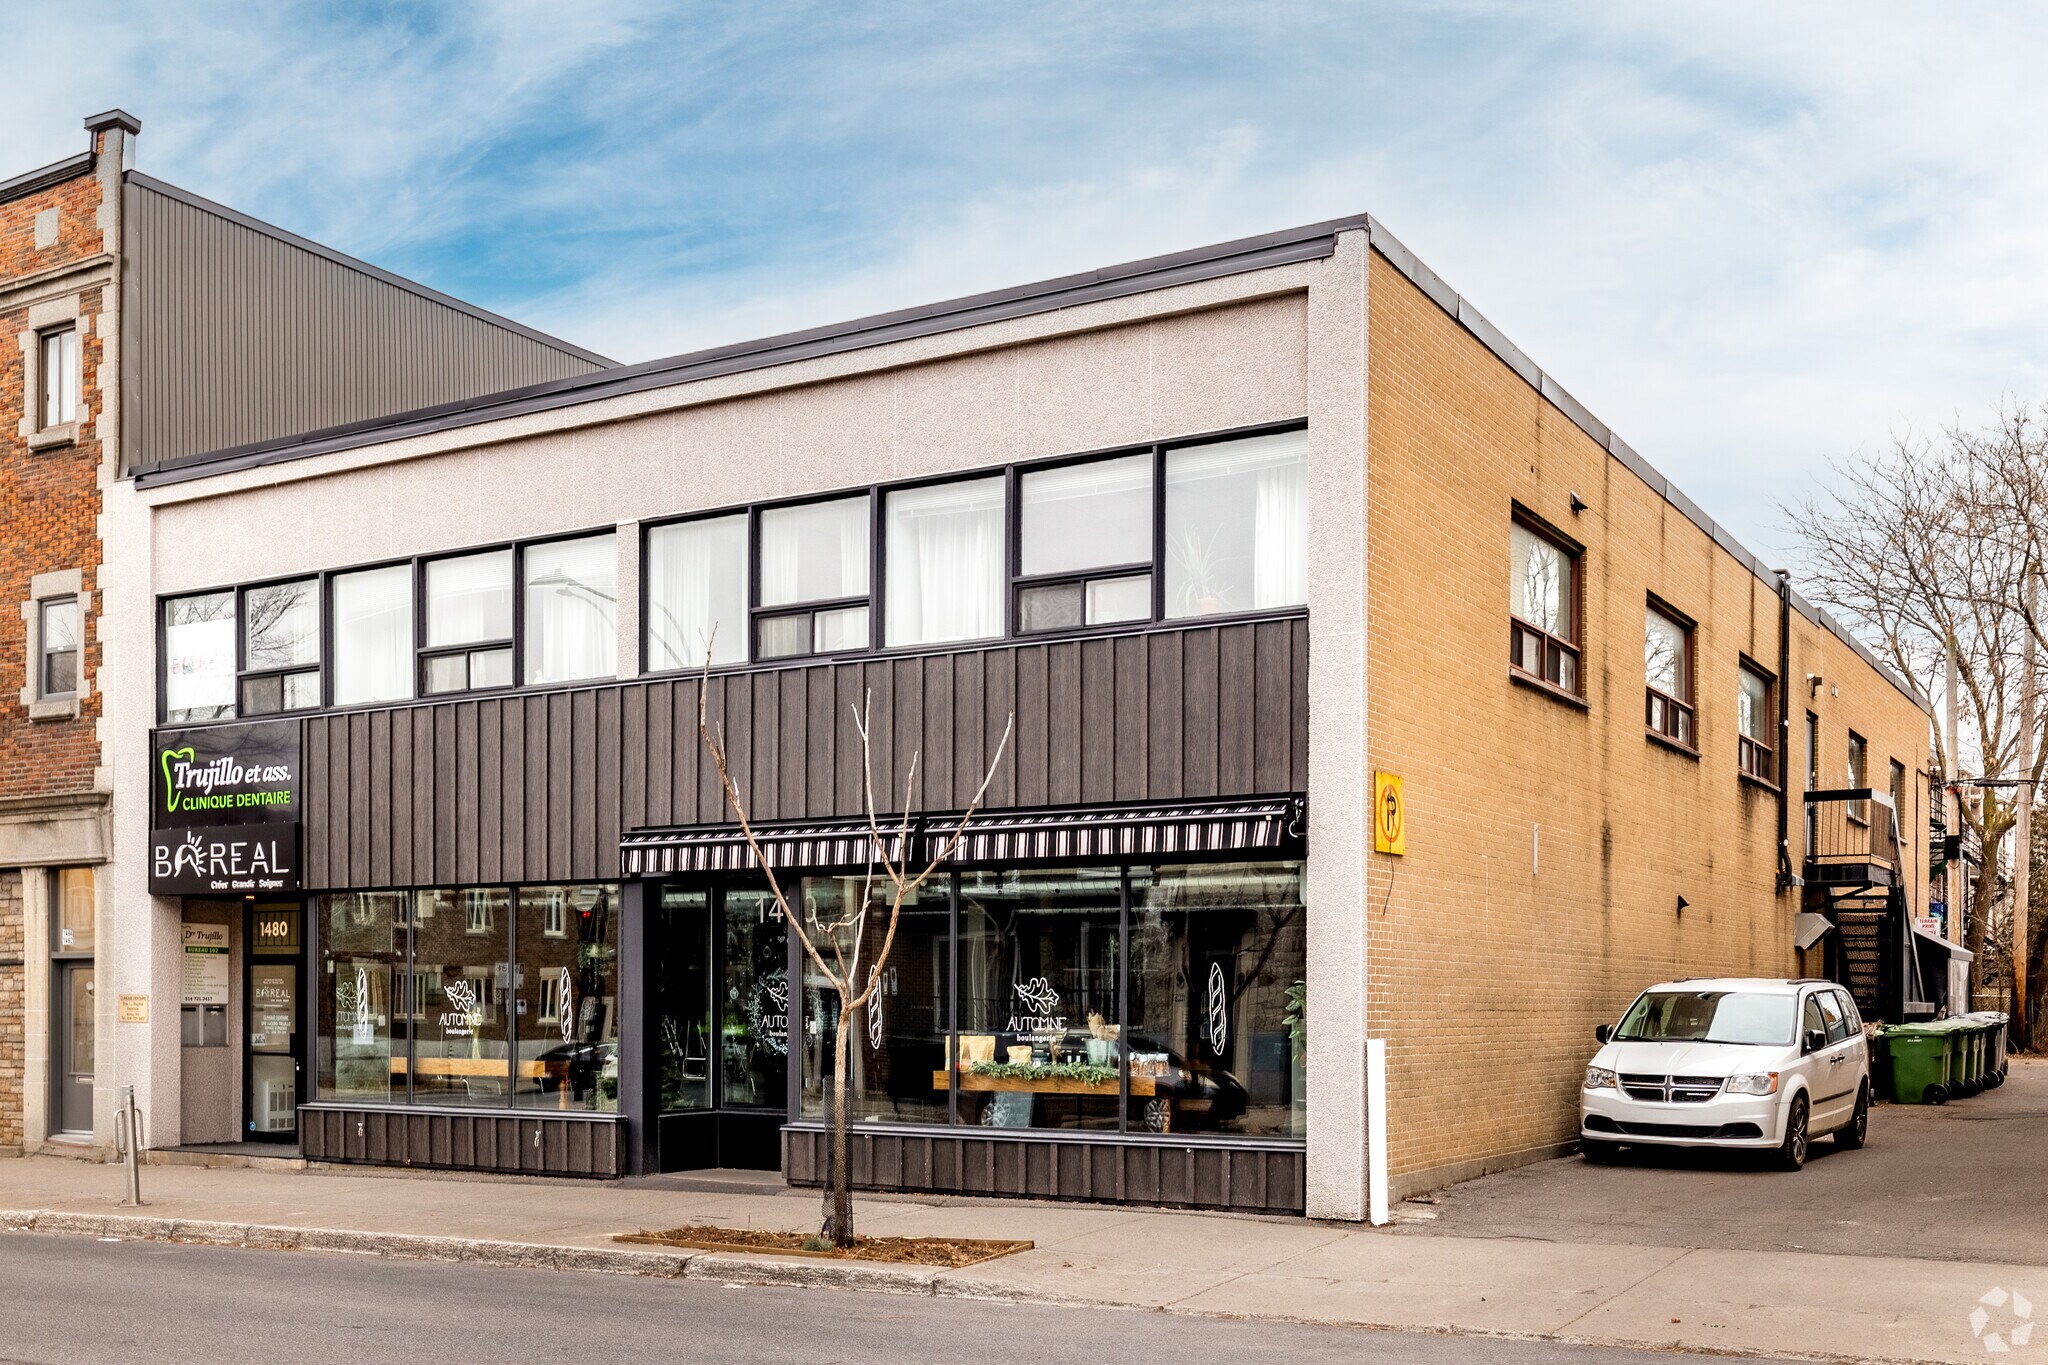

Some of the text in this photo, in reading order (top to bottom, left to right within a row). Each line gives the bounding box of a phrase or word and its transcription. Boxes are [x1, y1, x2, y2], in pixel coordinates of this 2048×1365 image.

[174, 757, 292, 795] Trujillo et ass.
[182, 790, 291, 811] CLINIQUE DENTAIRE
[258, 879, 284, 890] Soigner
[260, 921, 288, 937] 1480
[196, 931, 223, 943] Trujillo
[438, 1013, 483, 1026] AUTOMNE
[1005, 1016, 1068, 1031] AUTOMNE
[1016, 1033, 1057, 1043] boulangerie
